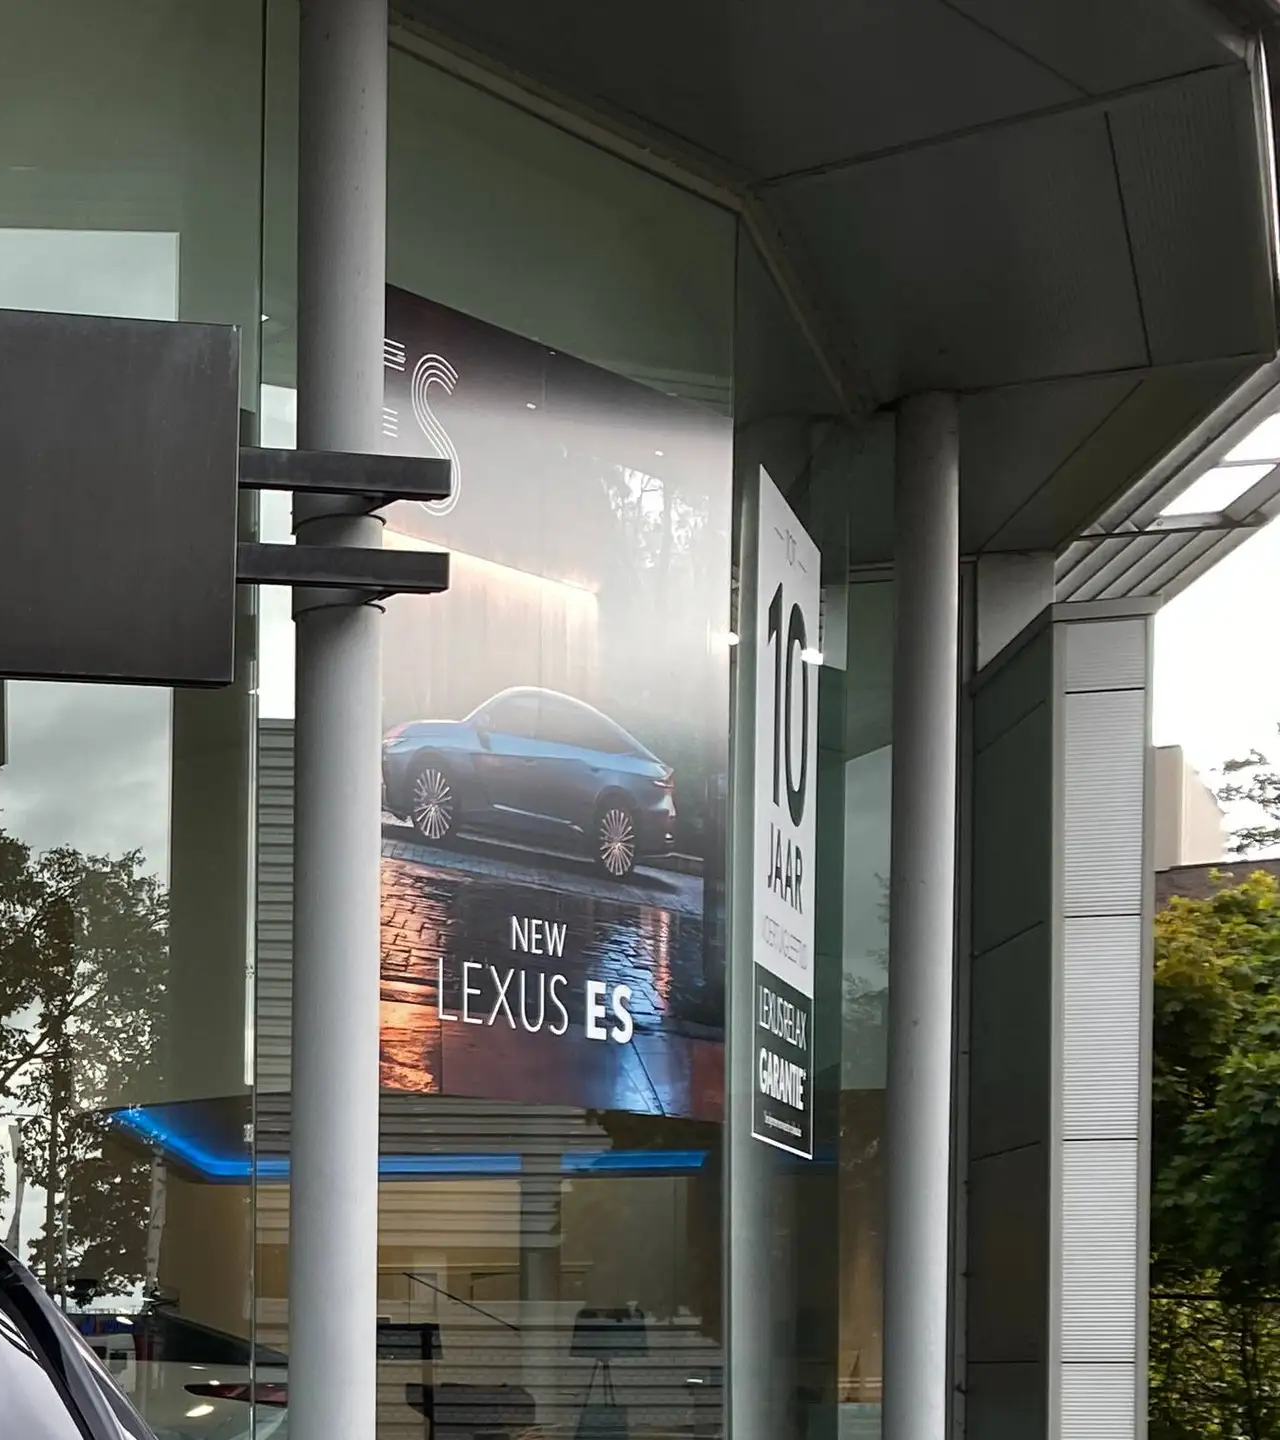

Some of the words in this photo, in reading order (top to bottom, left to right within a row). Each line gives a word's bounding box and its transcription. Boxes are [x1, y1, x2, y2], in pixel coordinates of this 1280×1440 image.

[767, 582, 808, 827] 10
[767, 822, 803, 914] JAAR
[512, 915, 567, 957] NEW
[438, 957, 569, 1036] LEXUS
[586, 979, 633, 1044] ES
